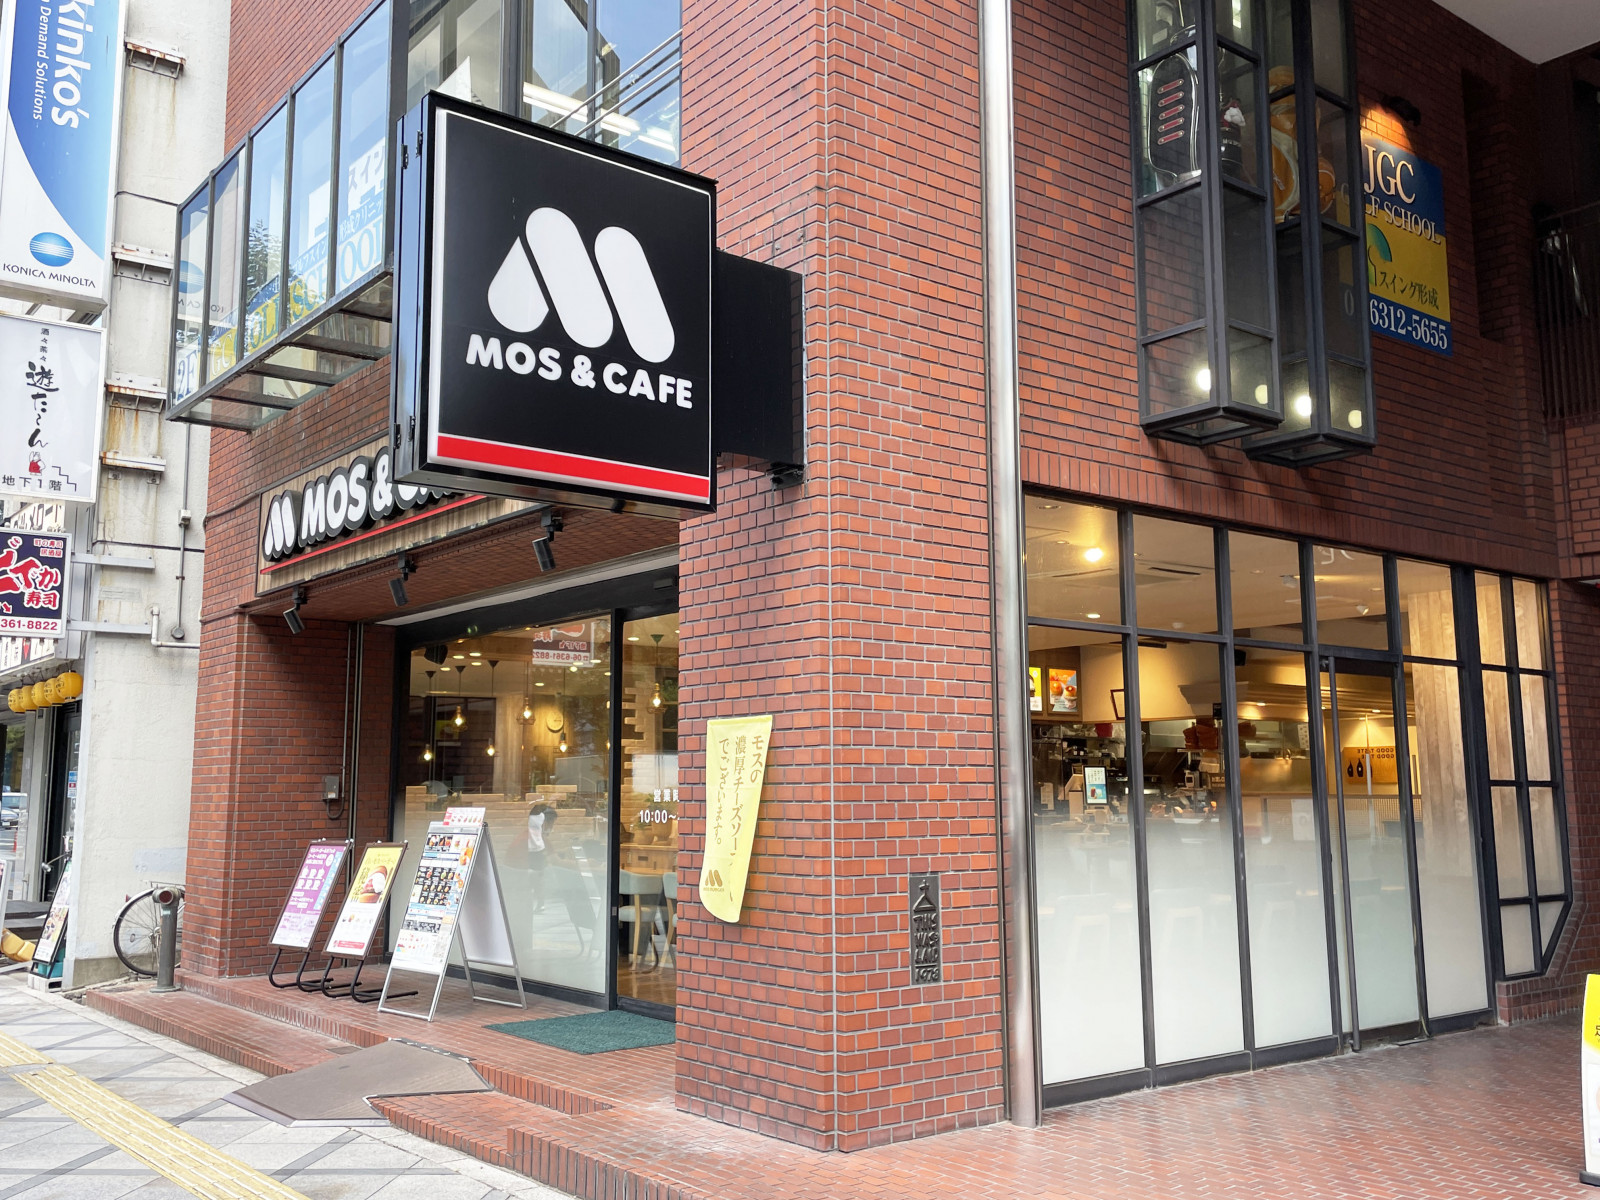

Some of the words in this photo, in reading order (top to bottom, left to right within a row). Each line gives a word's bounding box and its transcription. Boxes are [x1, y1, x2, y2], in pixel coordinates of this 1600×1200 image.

[36, 8, 52, 60] Demand
[33, 61, 48, 121] Solutions
[1364, 143, 1416, 204] JGC
[1383, 201, 1441, 245] SCHOOL
[3, 262, 46, 280] KONICA
[48, 272, 96, 289] MINOLTA
[1379, 271, 1440, 311] スイング形成
[1370, 299, 1448, 350] 6312-5655
[177, 349, 199, 400] 2F
[465, 333, 562, 382] MOS
[570, 354, 597, 389] &
[602, 362, 693, 410] CAFE
[2, 475, 62, 492] 地下1階
[301, 463, 367, 540] MOS
[34, 538, 63, 549] 町の寿司
[1, 618, 58, 631] 361-8822
[25, 591, 59, 610] 寿司
[751, 735, 765, 783] モスの
[713, 738, 730, 845] でございます。
[730, 735, 747, 866] 濃厚チーズソー
